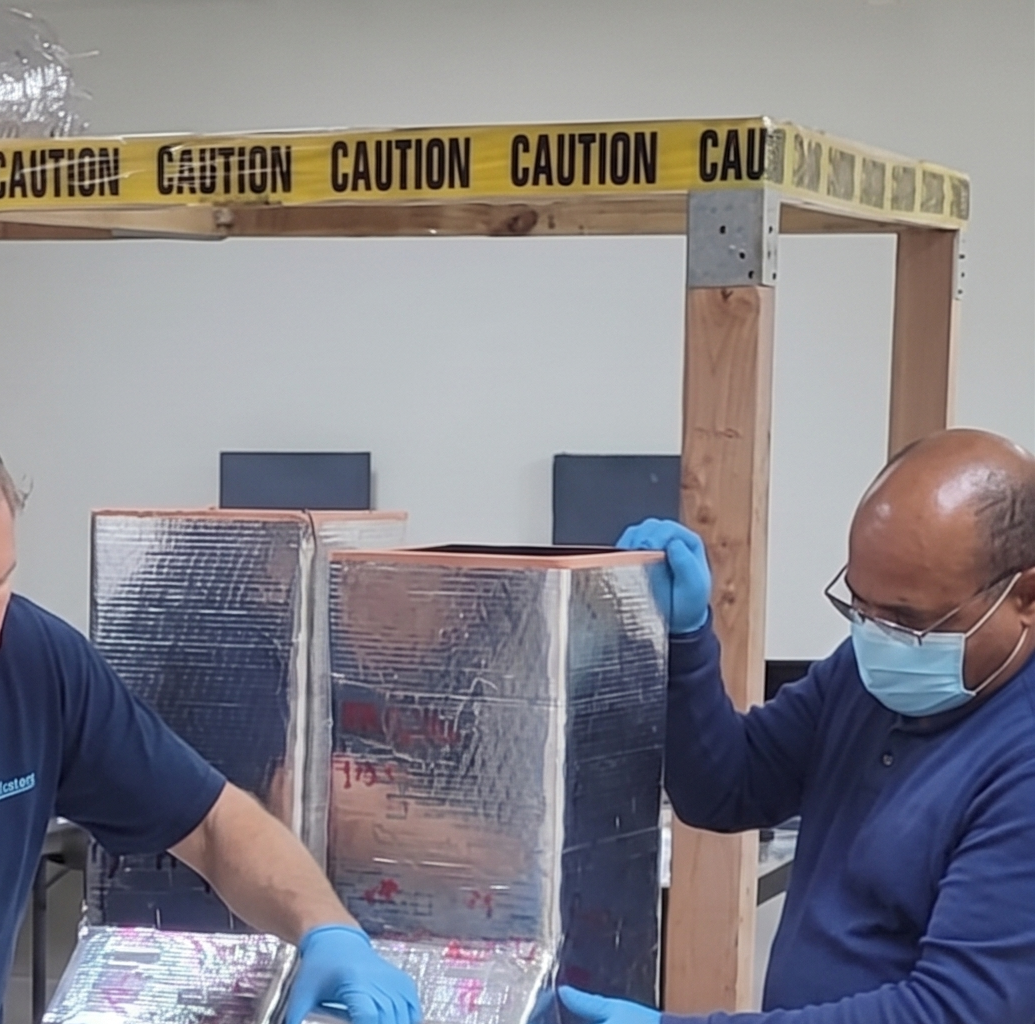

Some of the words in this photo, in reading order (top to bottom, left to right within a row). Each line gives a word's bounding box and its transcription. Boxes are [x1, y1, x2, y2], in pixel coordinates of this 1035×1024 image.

[157, 145, 292, 195] CAUTION
[331, 138, 471, 191] CAUTION
[510, 131, 658, 187] CAUTION
